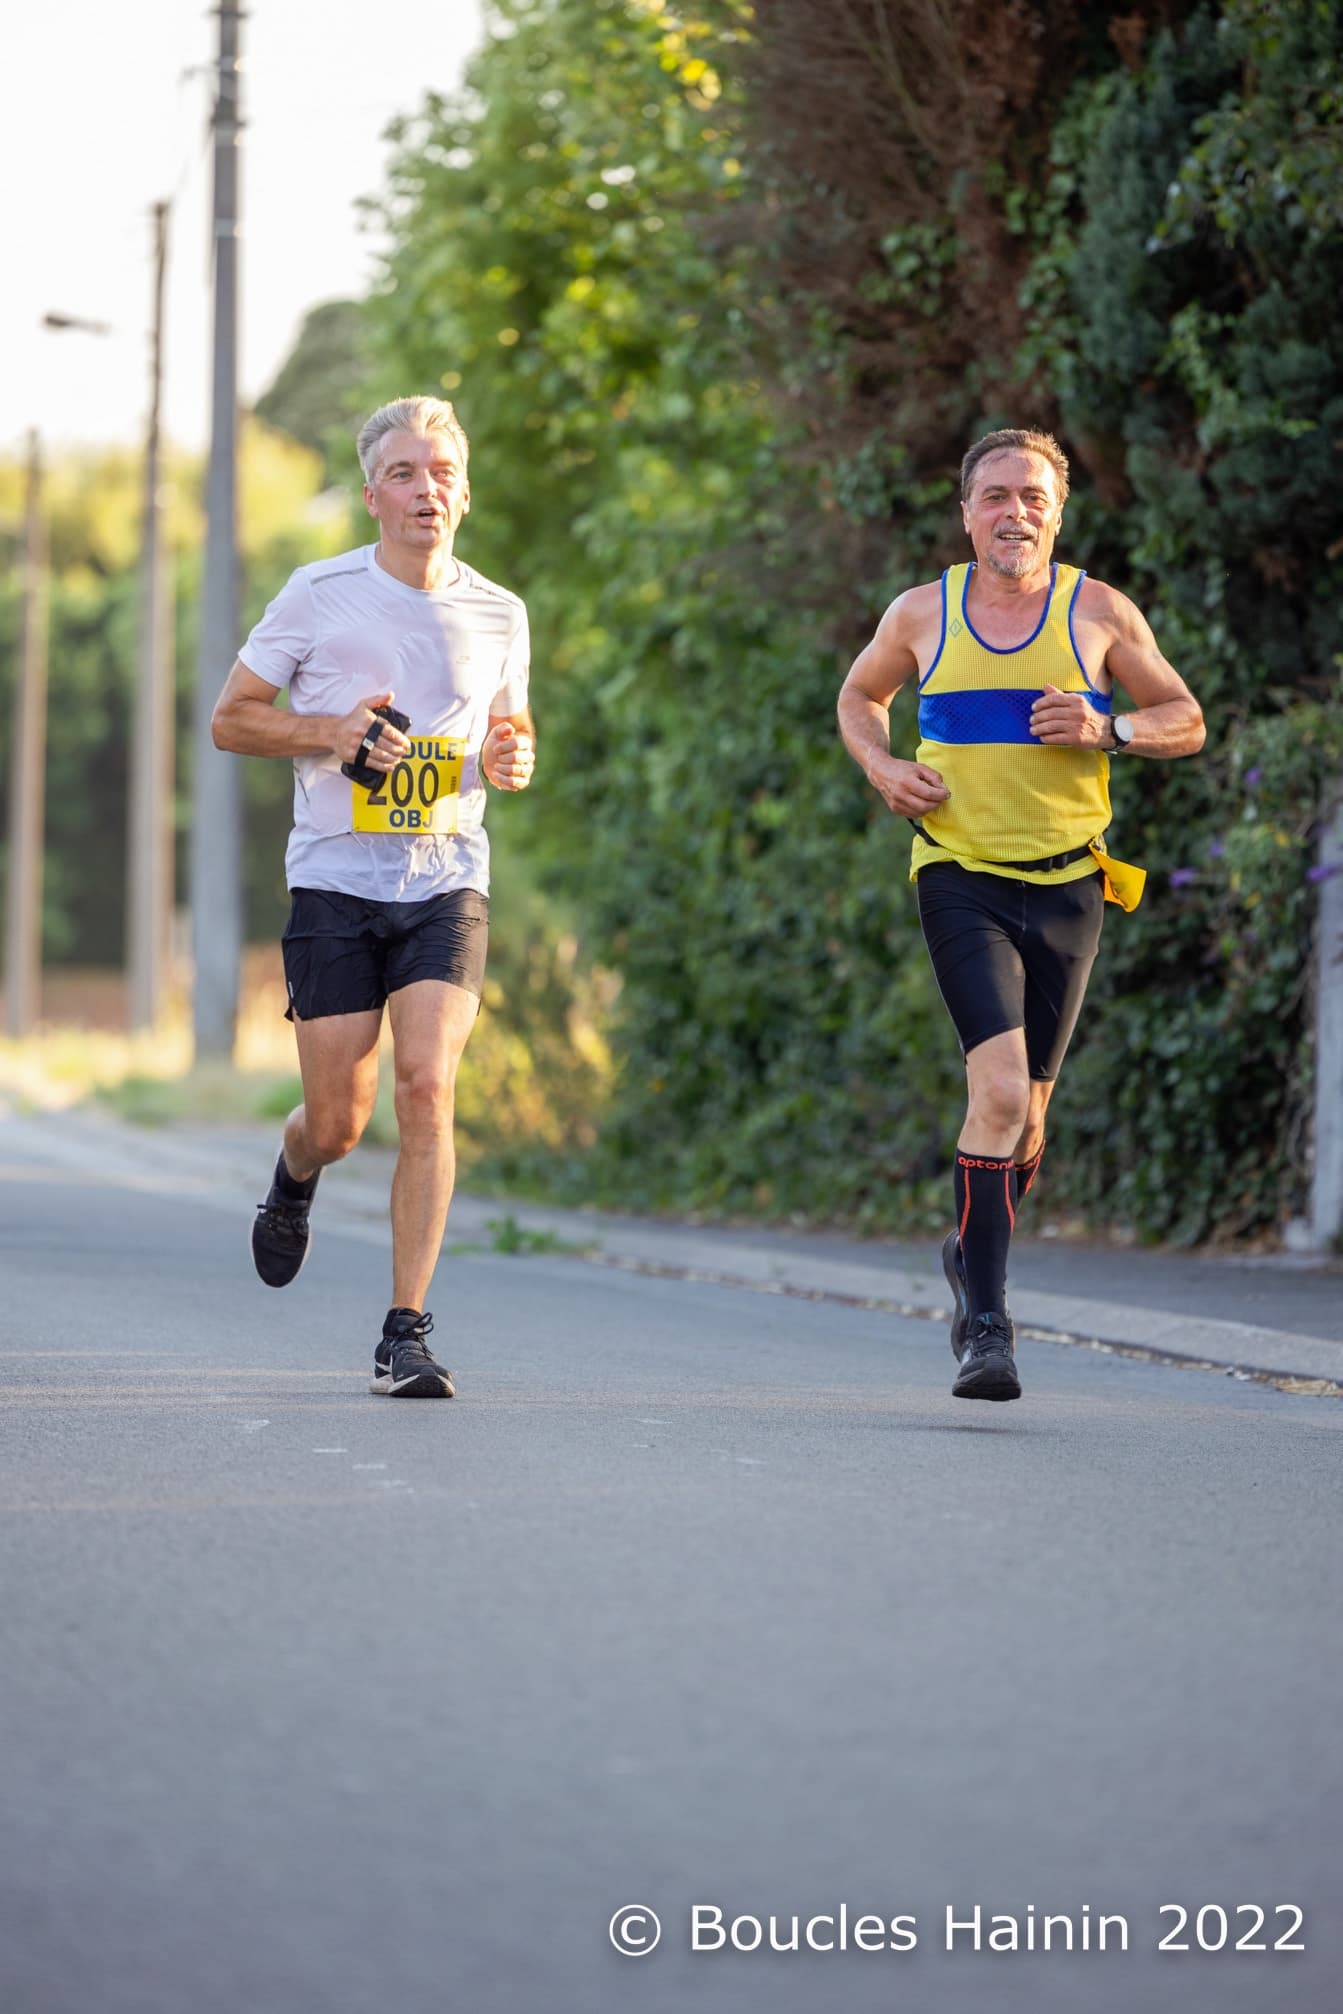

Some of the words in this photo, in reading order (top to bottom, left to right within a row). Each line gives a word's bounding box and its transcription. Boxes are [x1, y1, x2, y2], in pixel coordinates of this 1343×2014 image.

[402, 742, 457, 760] DULE
[367, 761, 439, 808] 200
[389, 809, 433, 828] OBJ
